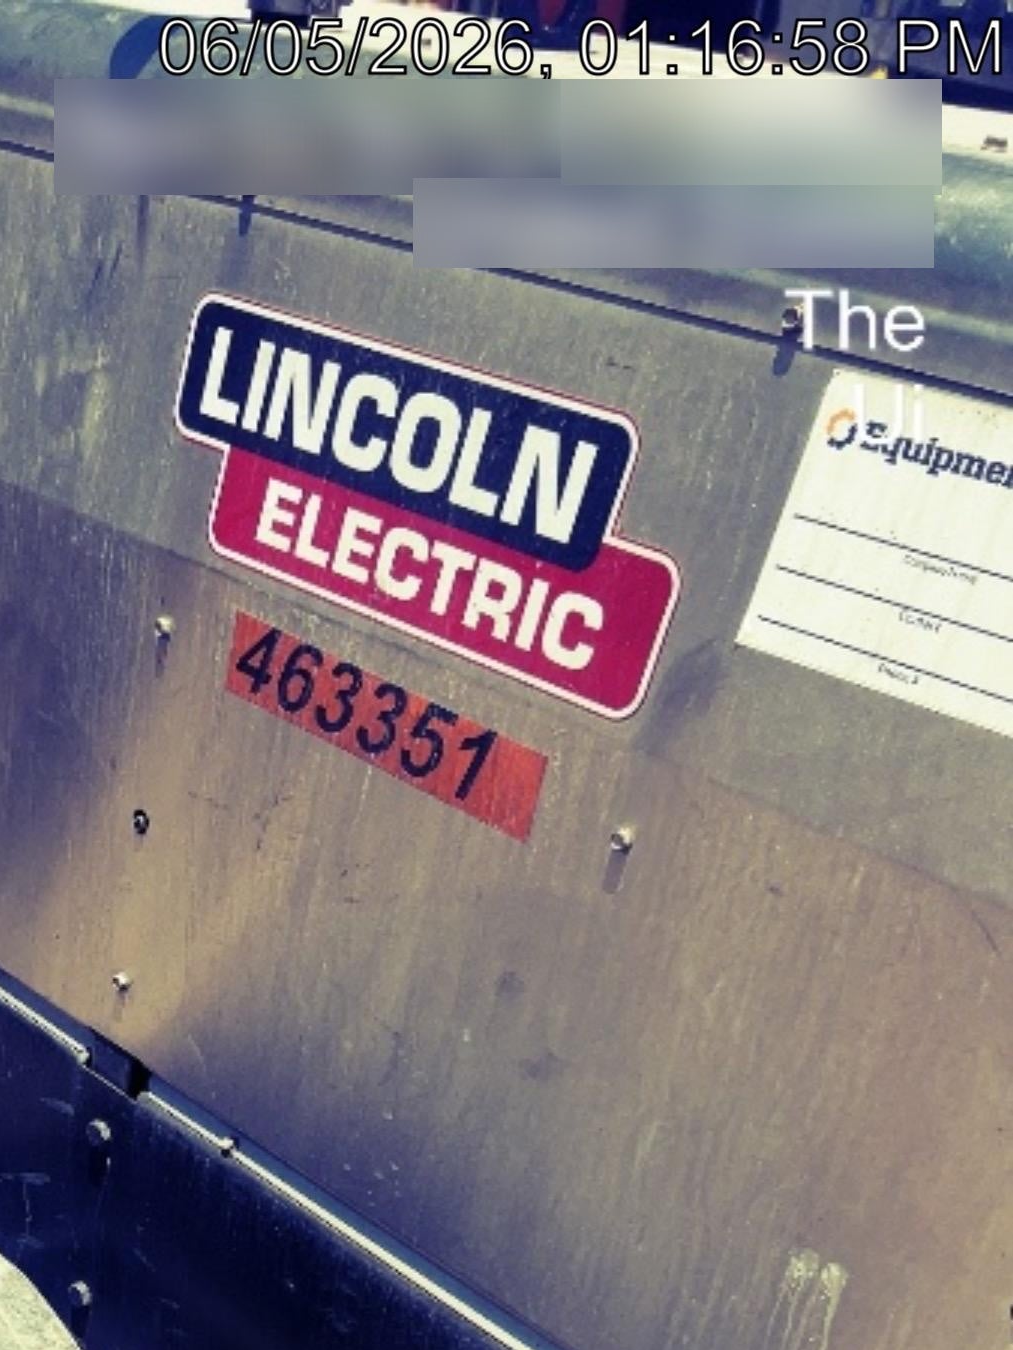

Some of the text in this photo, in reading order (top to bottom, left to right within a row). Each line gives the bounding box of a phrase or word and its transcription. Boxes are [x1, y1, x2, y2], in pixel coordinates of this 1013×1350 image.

[199, 326, 599, 545] LINCOLN
[255, 476, 604, 670] ELECTRIC
[236, 627, 498, 801] 463351
